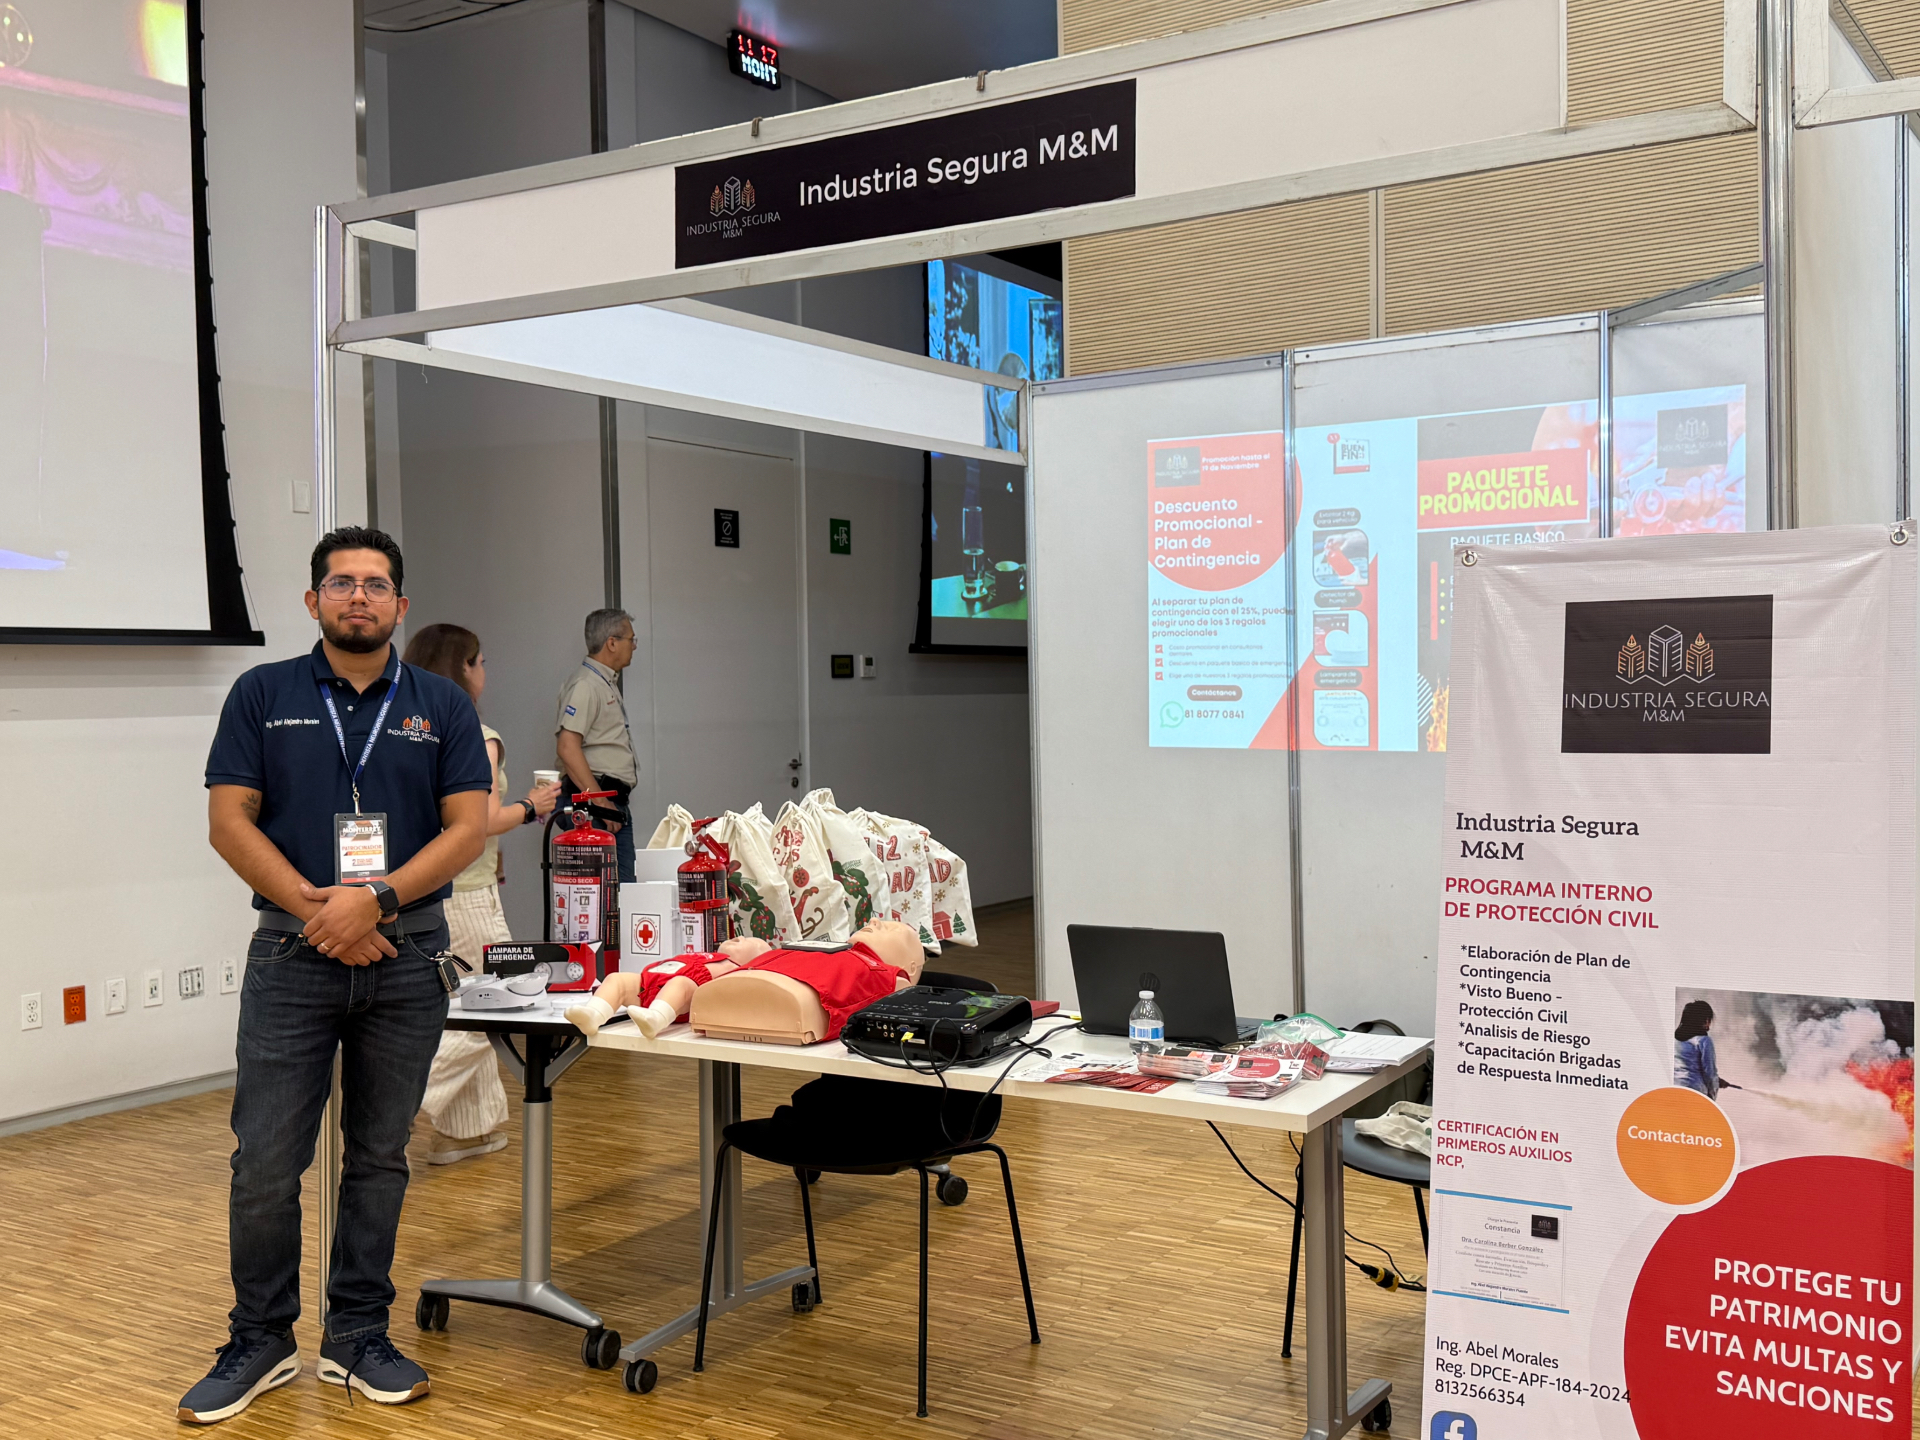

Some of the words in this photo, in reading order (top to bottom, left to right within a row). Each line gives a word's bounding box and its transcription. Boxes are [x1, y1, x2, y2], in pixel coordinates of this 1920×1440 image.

[761, 45, 777, 65] 17
[799, 163, 918, 206] Industria
[926, 147, 1028, 185] Segura
[1039, 124, 1118, 164] M&M
[686, 218, 739, 236] INDUSTRIA
[741, 211, 781, 228] SEGURA
[722, 228, 743, 239] M&M
[1341, 443, 1365, 452] BUEN
[1341, 451, 1358, 460] FIN
[1220, 462, 1260, 471] Noviembre
[1447, 465, 1549, 493] PAQUETE
[1154, 498, 1238, 514] Descuento
[1419, 484, 1579, 516] PROMOCIONAL
[1154, 514, 1252, 532] Promocional
[1154, 536, 1188, 550] Plan
[1191, 534, 1212, 548] de
[1514, 530, 1565, 545] BASICO
[1154, 550, 1260, 570] Contingencia
[1152, 598, 1160, 606] Al
[1162, 598, 1197, 607] separar
[1198, 597, 1208, 605] tu
[1209, 597, 1230, 607] plan
[1231, 596, 1243, 604] de
[1152, 608, 1210, 617] contingencia
[1231, 607, 1239, 615] el
[1152, 619, 1176, 628] elegir
[1197, 618, 1209, 626] de
[1210, 618, 1223, 626] los
[1225, 618, 1230, 626] 3
[1232, 617, 1266, 627] regalos
[1152, 629, 1218, 639] promocionales
[1564, 692, 1676, 710] INDUSTRIA
[1684, 690, 1770, 708] SEGURA
[1184, 710, 1194, 718] 81
[1196, 710, 1220, 718] 8077
[1222, 710, 1245, 719] 0841
[1642, 709, 1685, 722] M&M
[387, 728, 420, 737] INDUSTRIA
[360, 743, 373, 766] DENTISTA
[1455, 813, 1555, 833] Industria
[1561, 815, 1639, 838] Segura
[1460, 840, 1525, 861] M&M
[1445, 877, 1556, 898] PROGRAMA
[1561, 882, 1653, 903] INTERNO
[1444, 902, 1470, 918] DE
[1475, 902, 1602, 926] PROTECCIÓN
[1608, 911, 1659, 929] CIVIL
[488, 953, 535, 961] EMERGENCIA
[1554, 950, 1572, 965] de
[1576, 953, 1608, 967] Plan
[1612, 954, 1631, 969] de
[1460, 964, 1551, 984] Contingencia
[1506, 987, 1552, 1003] Bueno
[1459, 1003, 1534, 1021] Protección
[1537, 1008, 1568, 1024] Civil
[1521, 1026, 1540, 1041] de
[1543, 1029, 1591, 1048] Riesgo
[1559, 1052, 1621, 1070] Brigadas
[1457, 1060, 1475, 1074] de
[1479, 1063, 1552, 1083] Respuesta
[1555, 1070, 1629, 1090] Inmediata
[1437, 1119, 1537, 1142] CERTIFICACIÓN
[1540, 1130, 1559, 1144] EN
[1627, 1125, 1723, 1149] Contactanos
[1437, 1137, 1506, 1155] PRIMEROS
[1509, 1145, 1573, 1163] AUXILIOS
[1436, 1154, 1465, 1169] RCP,
[1484, 1223, 1521, 1235] Constancia
[1474, 1238, 1497, 1247] Carolina
[1714, 1257, 1852, 1299] PROTEGE
[1860, 1277, 1901, 1306] TU
[1710, 1294, 1901, 1345] PATRIMONIO
[1436, 1336, 1461, 1357] Ing.
[1465, 1340, 1498, 1359] Abel
[1502, 1346, 1559, 1369] Morales
[1665, 1324, 1745, 1360] EVITA
[1753, 1338, 1874, 1380] MULTAS
[1881, 1358, 1903, 1384] Y
[1436, 1357, 1466, 1378] Reg.
[1470, 1362, 1631, 1403] DPCE-APF-184-2024
[1435, 1379, 1525, 1407] 8132566354
[1716, 1370, 1894, 1423] SANCIONES
